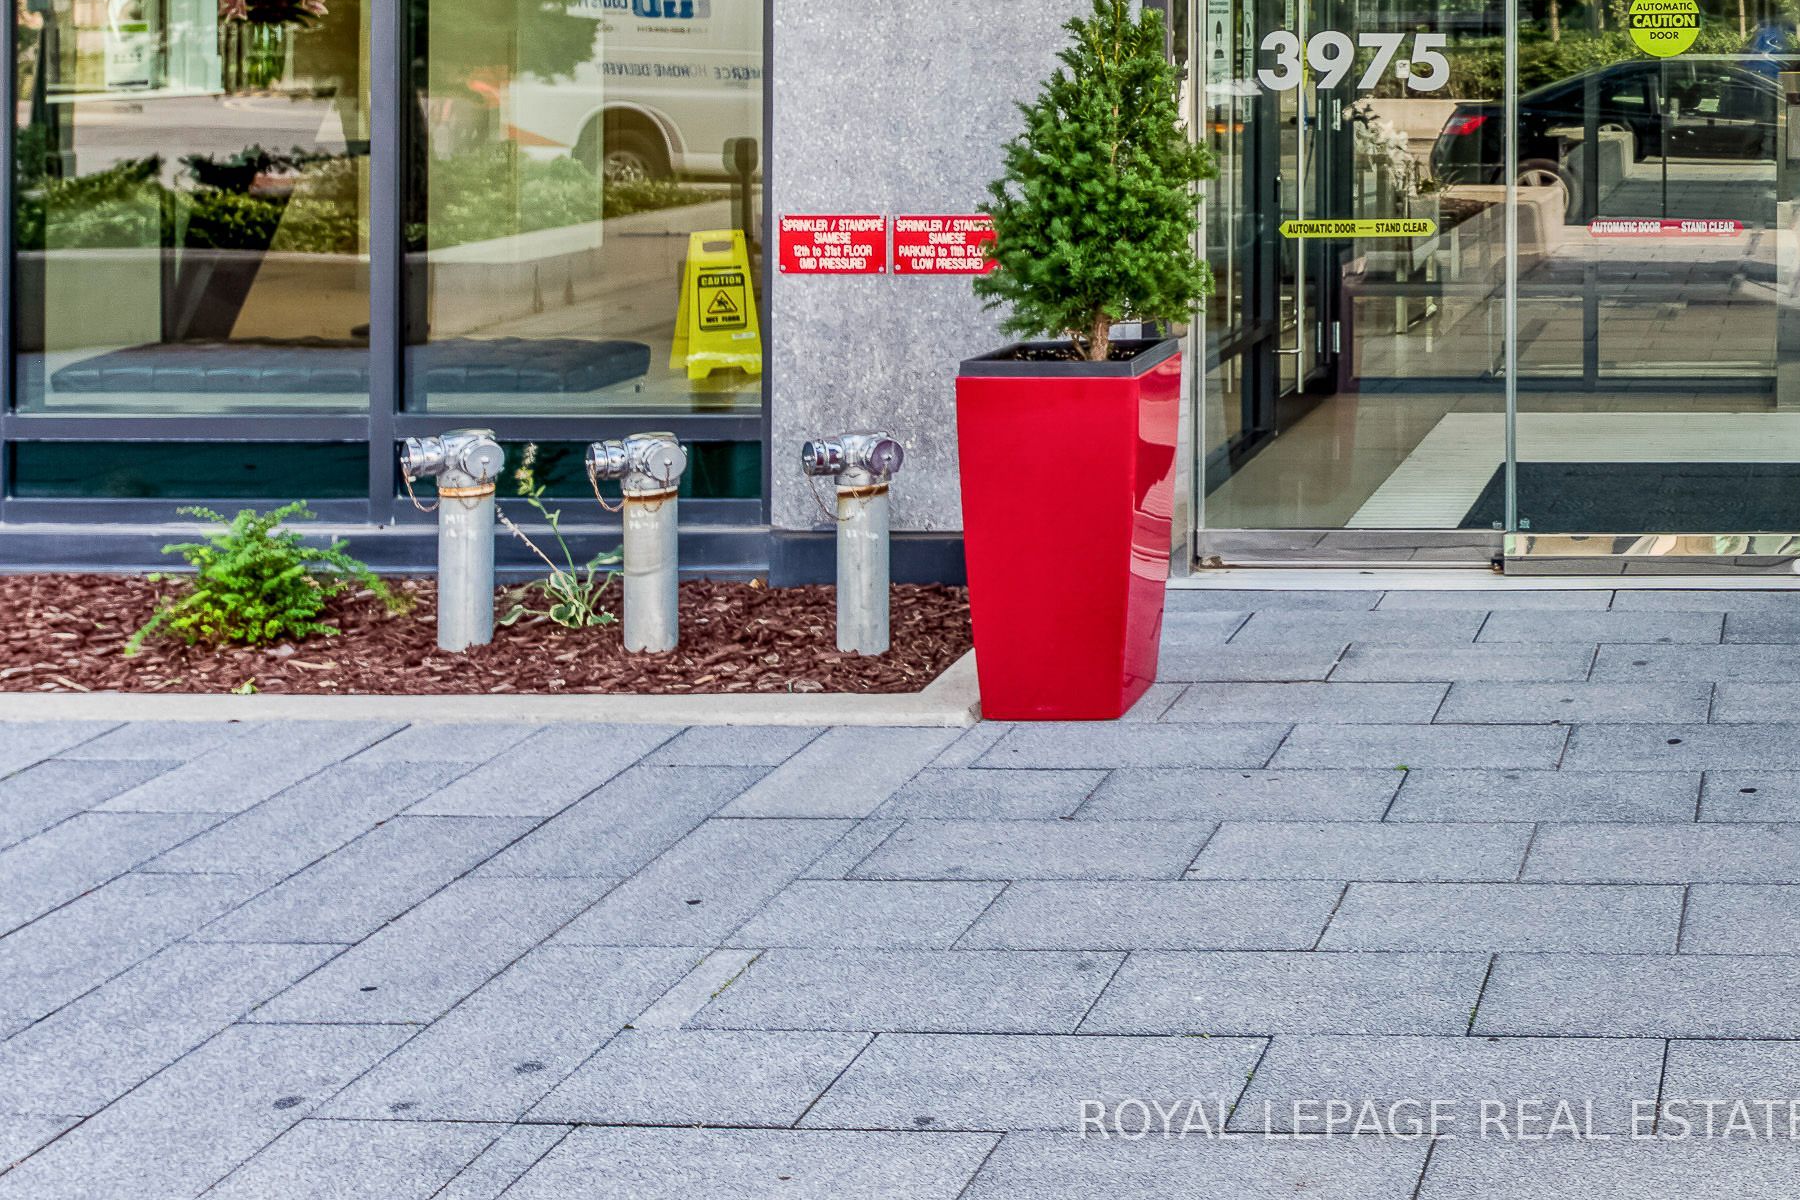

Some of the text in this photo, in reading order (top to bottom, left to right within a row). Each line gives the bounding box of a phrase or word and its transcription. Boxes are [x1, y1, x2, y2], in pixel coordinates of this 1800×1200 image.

[1636, 2, 1693, 11] AUTOMATIC
[1633, 14, 1696, 28] CAUTION
[1650, 31, 1679, 40] DOOR
[1257, 30, 1450, 92] 3975
[782, 219, 828, 232] SPRINKLER
[838, 219, 884, 232] STANDPIPE
[896, 219, 943, 232] SPRINKLER
[1287, 222, 1427, 234] AUTOMATIC DOOR STAND CLEAR
[1591, 221, 1735, 233] AUTOMATIC DOOR STAND CLEAR
[814, 232, 852, 244] SIAMESE
[928, 232, 967, 245] SIAMESE
[793, 244, 873, 257] 12th to 31st FLOOR
[898, 245, 936, 257] PARKING
[937, 246, 948, 257] to
[819, 257, 867, 270] PRESSURE)
[911, 258, 984, 270] (LOW PRESSURE)
[701, 275, 741, 286] CAUTION
